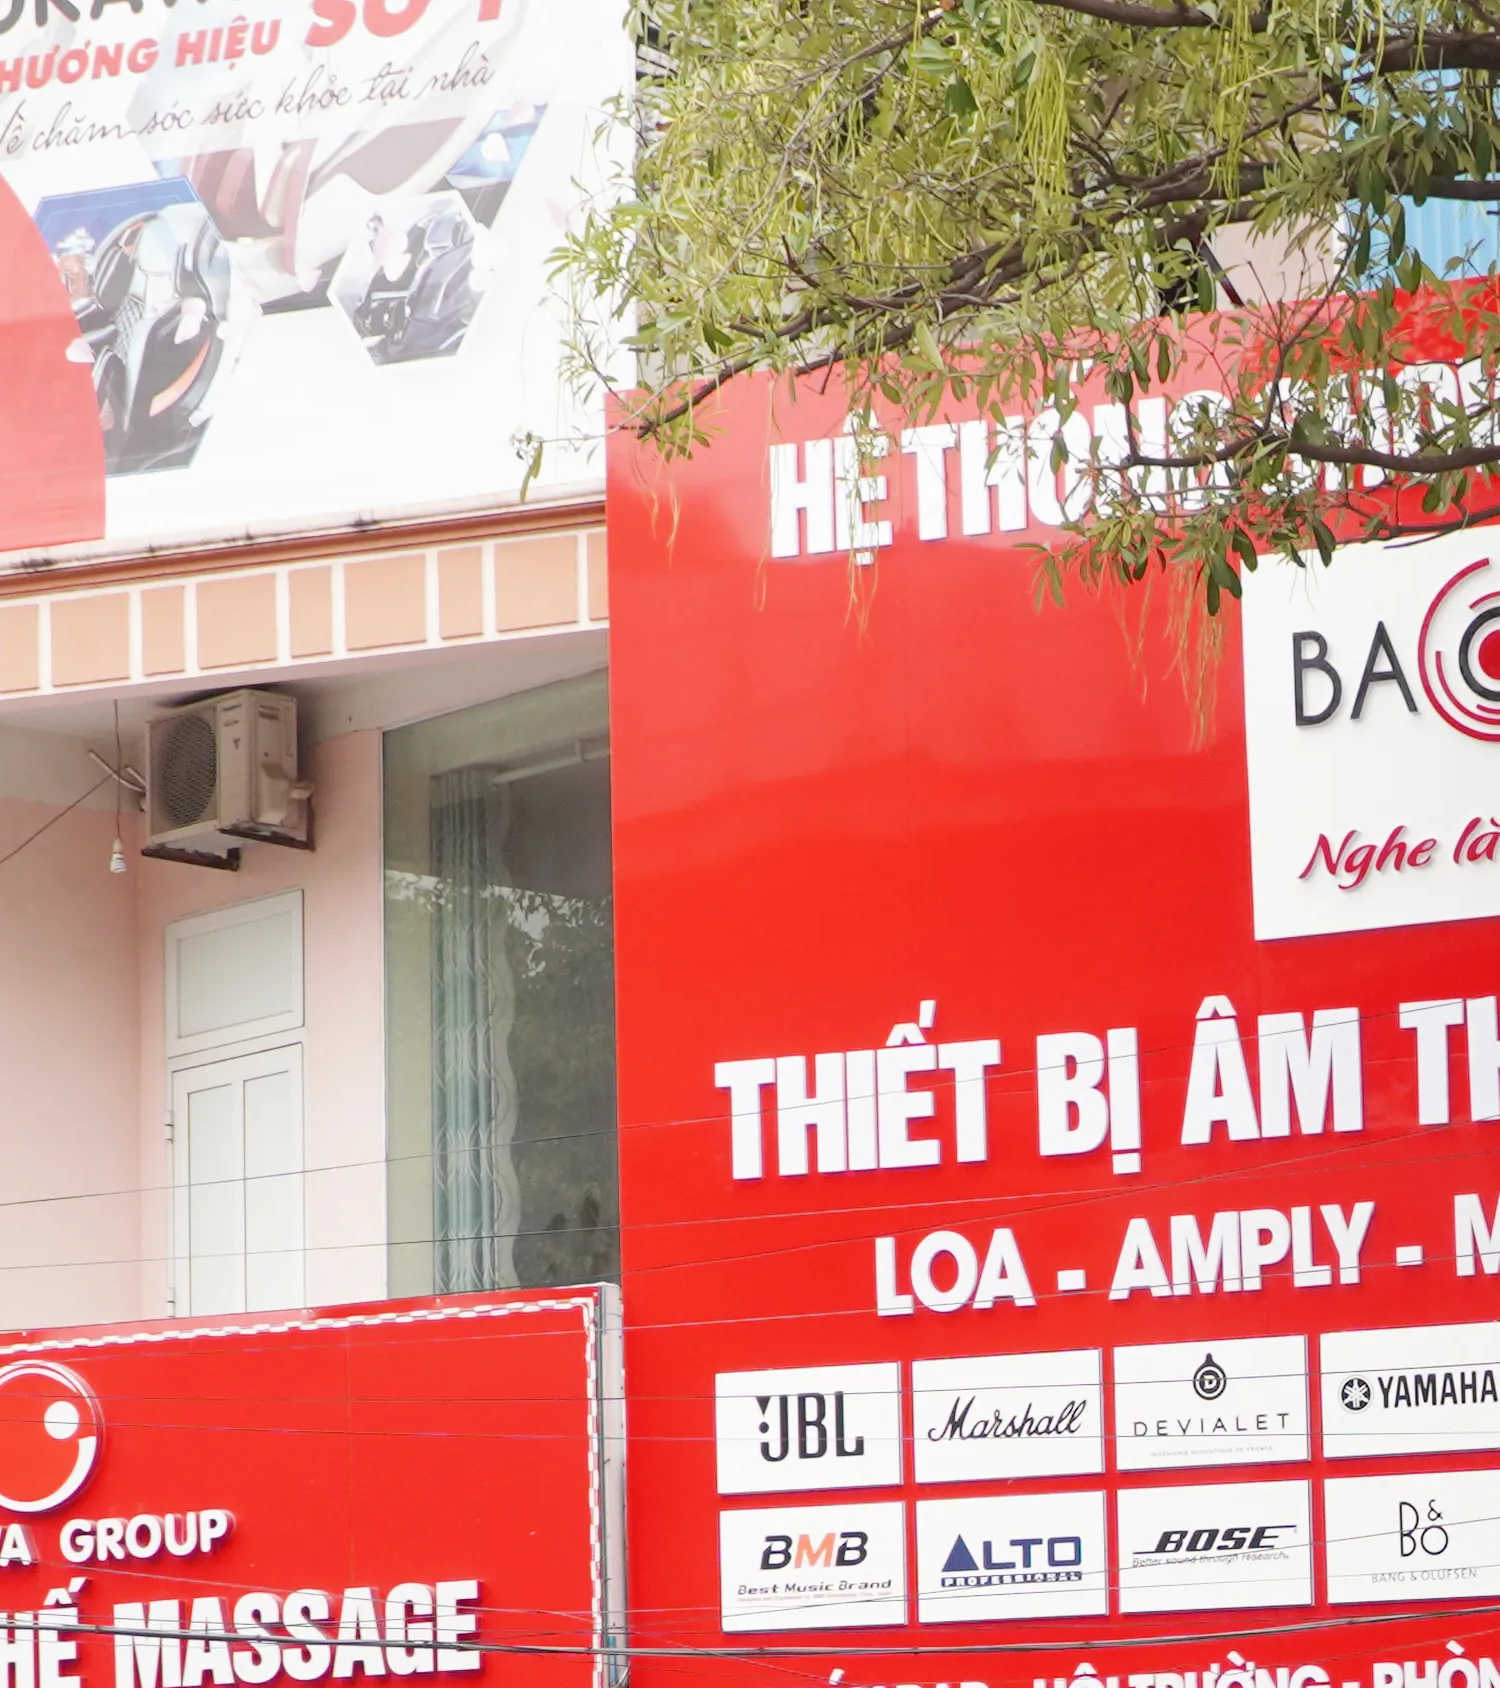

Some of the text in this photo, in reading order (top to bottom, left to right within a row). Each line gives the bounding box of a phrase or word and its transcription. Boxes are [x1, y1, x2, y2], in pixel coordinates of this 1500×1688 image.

[175, 14, 282, 71] HIỆU
[770, 409, 894, 565] HỆ
[1298, 828, 1436, 890] Nghe
[1453, 817, 1500, 866] là
[714, 999, 1001, 1181] THIẾT
[1035, 1026, 1142, 1175] BỊ
[1180, 994, 1364, 1147] ÂM
[873, 1226, 1037, 1319] LOA
[1108, 1200, 1376, 1303] AMPLY
[1378, 1369, 1498, 1409] YAMAHA
[756, 1391, 865, 1463] JBL
[927, 1395, 1088, 1442] Marshall
[1132, 1412, 1291, 1438] DEVIALET
[58, 1509, 231, 1566] GROUP
[760, 1532, 869, 1571] BMB
[940, 1533, 1083, 1573] ALTO
[1140, 1525, 1297, 1553] BOSE
